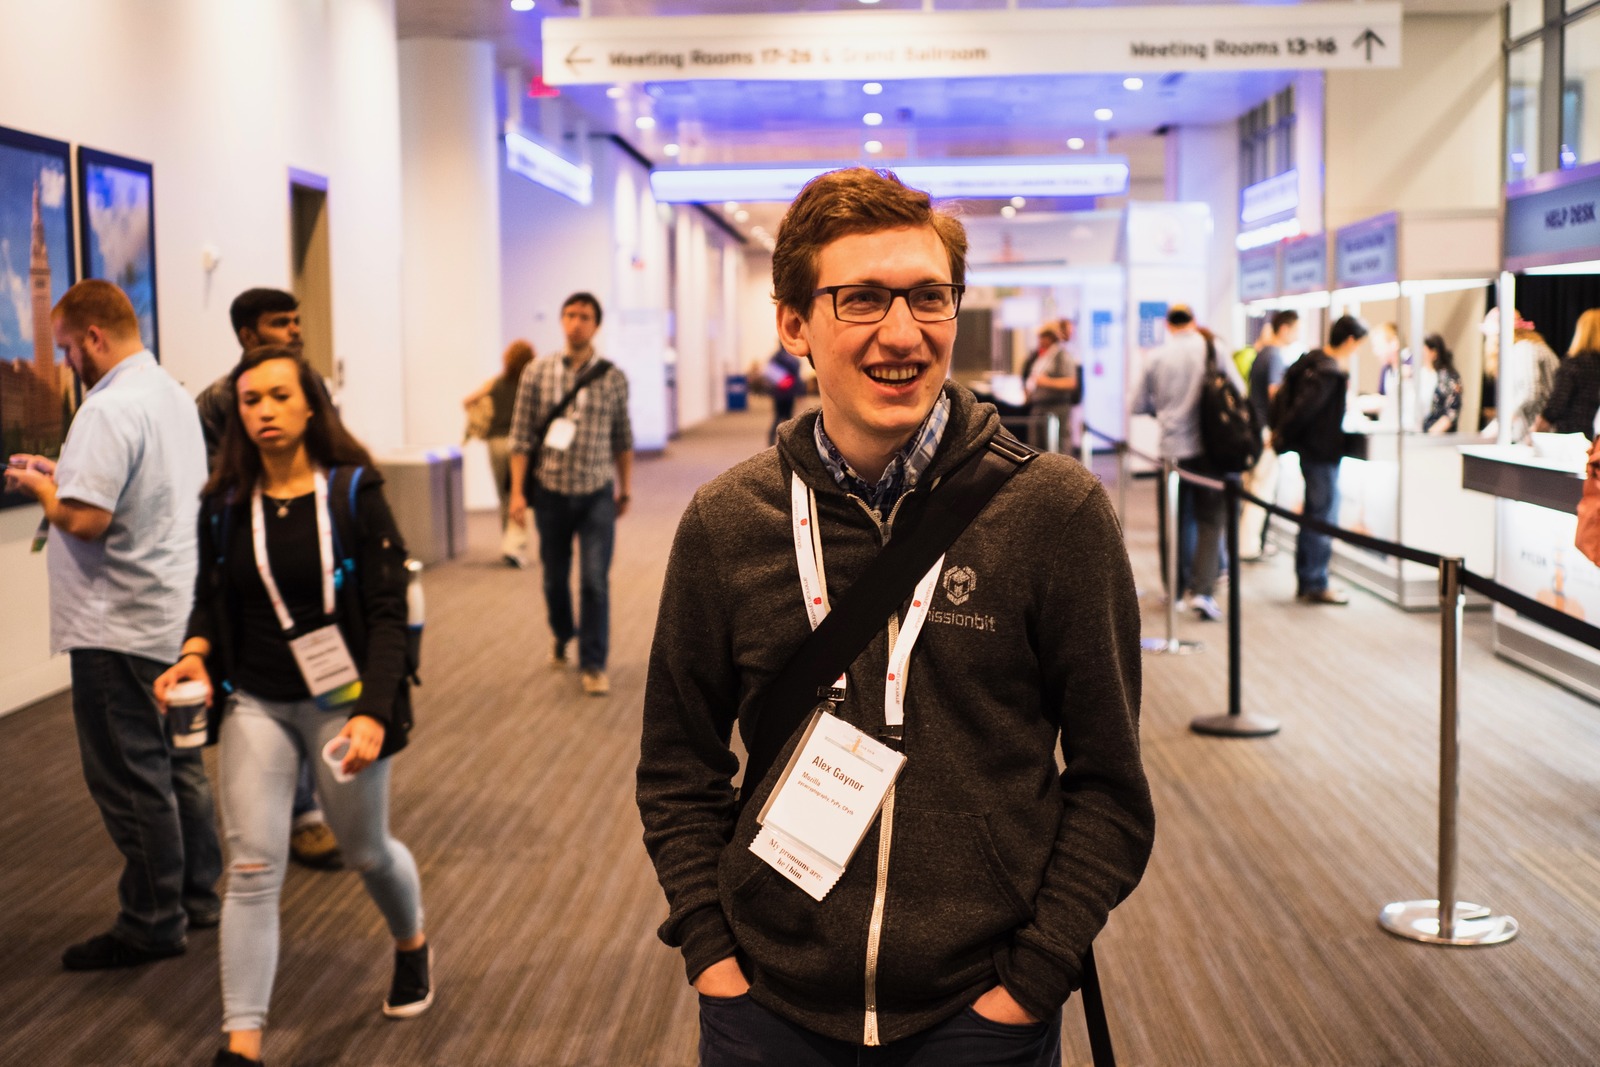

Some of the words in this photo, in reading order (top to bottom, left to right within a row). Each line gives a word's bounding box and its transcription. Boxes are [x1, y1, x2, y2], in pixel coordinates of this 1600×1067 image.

[609, 50, 684, 69] Meeting
[691, 49, 754, 66] Rooms
[761, 48, 812, 65] 17-26
[904, 46, 988, 63] Ballroom
[1131, 40, 1207, 60] Meeting
[1215, 38, 1280, 57] Rooms
[1287, 37, 1337, 55] 13-16
[803, 577, 812, 602] american
[802, 771, 821, 787] Mozilla
[812, 755, 832, 773] Alex
[832, 767, 865, 792] Gaynor
[769, 838, 781, 852] My
[780, 846, 810, 873] pronouns
[776, 857, 786, 869] he
[788, 866, 802, 880] him
